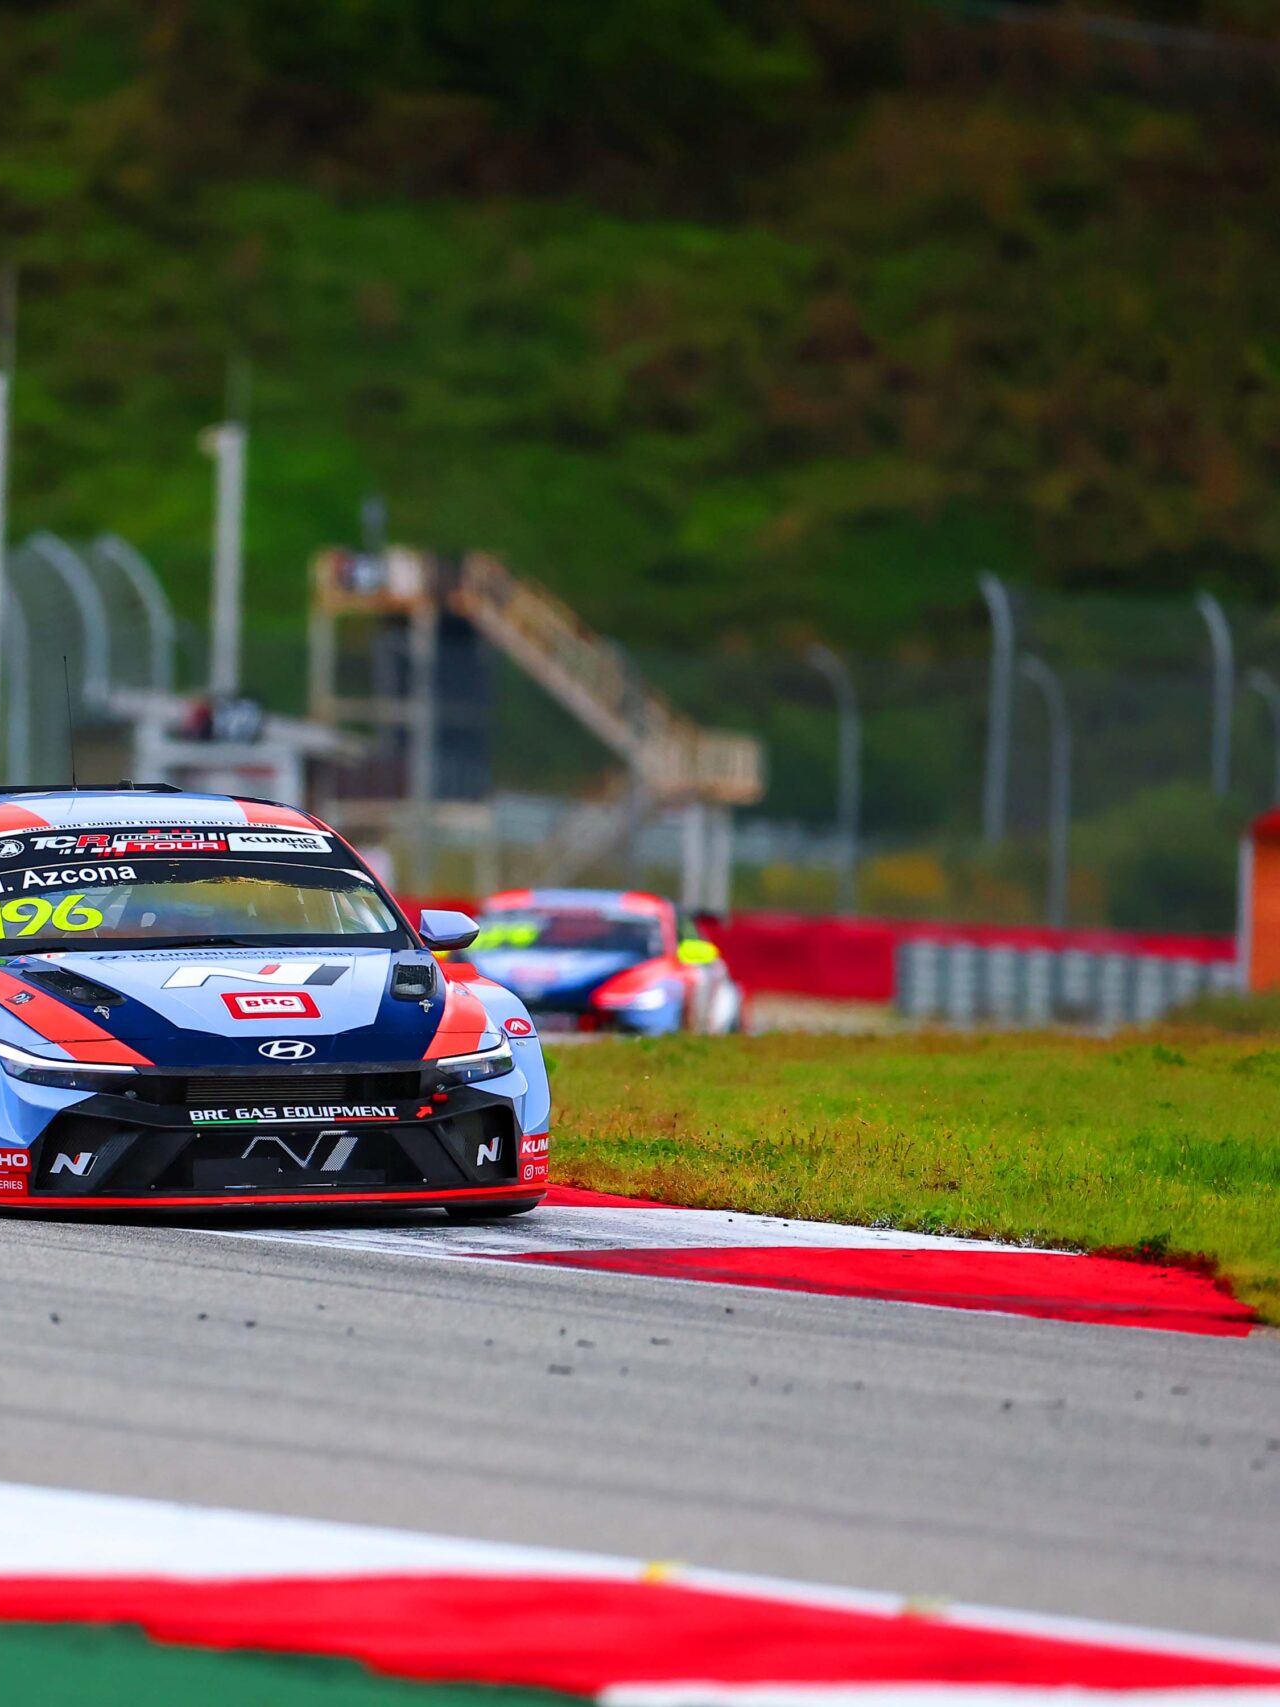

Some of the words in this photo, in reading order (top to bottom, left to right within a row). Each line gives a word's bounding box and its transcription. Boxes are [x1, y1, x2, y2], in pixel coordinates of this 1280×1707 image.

[30, 834, 110, 850] TCR
[134, 842, 220, 850] TOUR
[239, 836, 317, 844] KUMHO
[22, 866, 136, 889] Azcona
[245, 998, 295, 1007] BRC
[189, 1110, 230, 1121] BRC
[235, 1108, 276, 1119] GAS
[282, 1106, 397, 1118] EQUIPMENT
